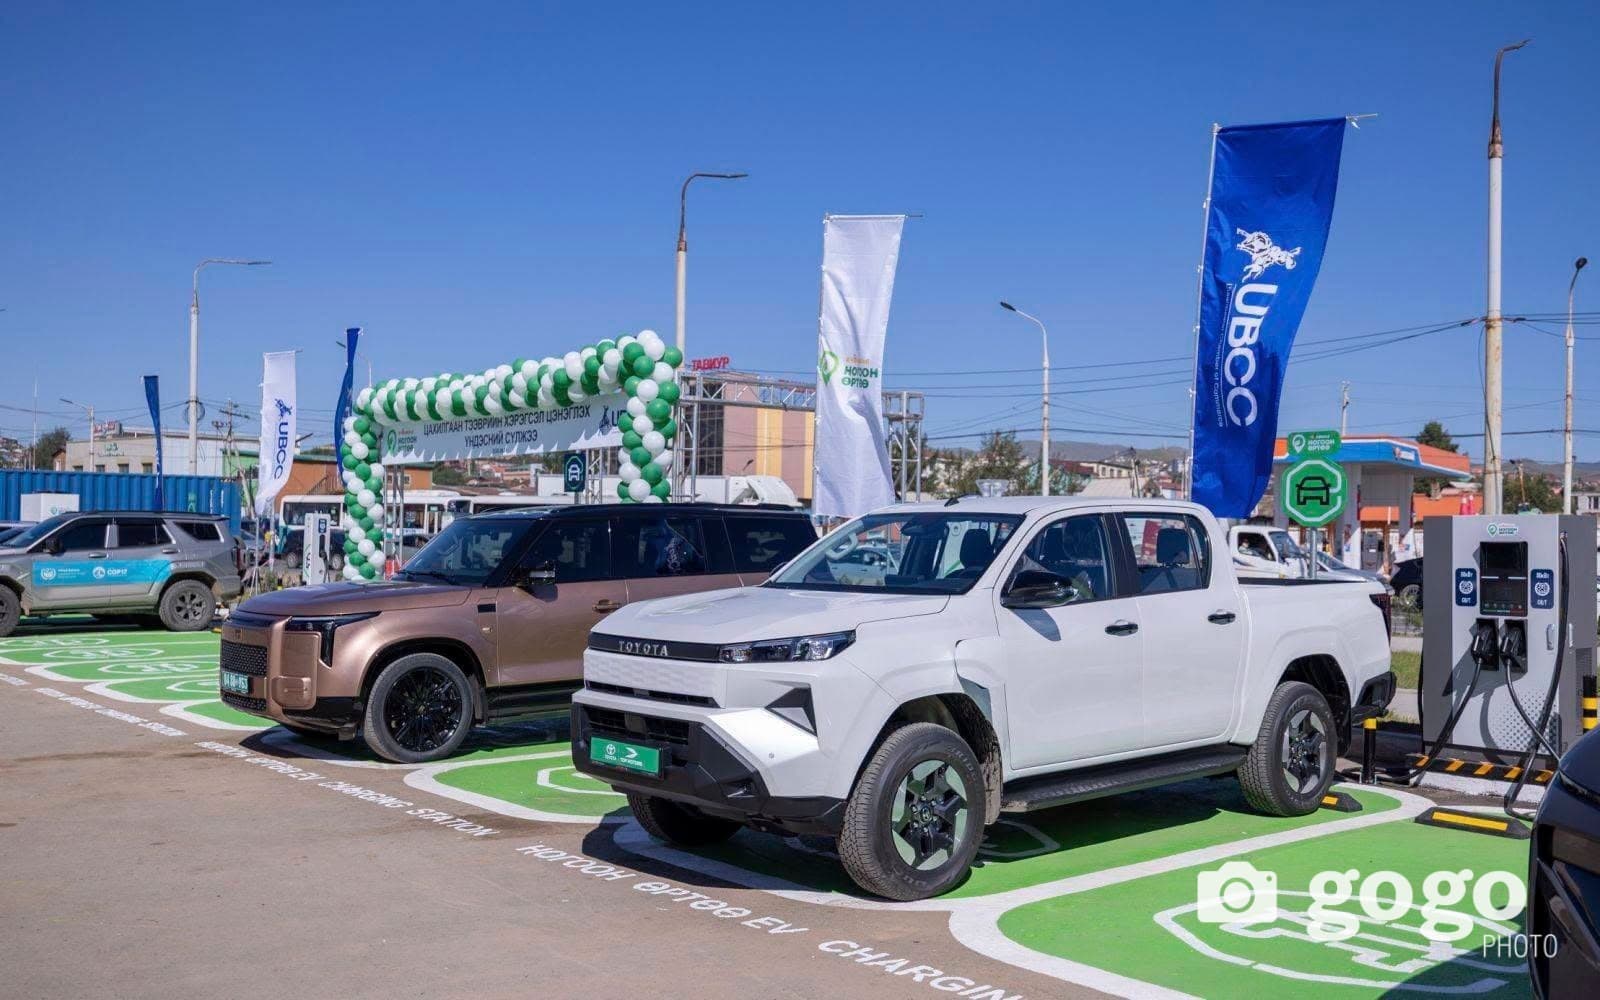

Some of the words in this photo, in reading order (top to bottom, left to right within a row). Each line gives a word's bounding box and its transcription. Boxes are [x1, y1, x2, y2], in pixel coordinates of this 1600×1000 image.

[1224, 283, 1278, 427] UBCC
[423, 420, 463, 437] ЦАХИЛГААН
[464, 415, 503, 431] ТЭЭВРИЙН
[504, 411, 545, 427] ХЭРЭГСЭЛ
[546, 404, 591, 423] ЦЭНЭГЛЭХ
[274, 421, 289, 480] UBCC
[464, 430, 504, 448] ҮНДЭСНИЙ
[504, 429, 538, 444] СҮЛЖЭЭ
[619, 640, 668, 656] TOYOTA
[406, 808, 500, 837] STATION
[516, 844, 637, 881] НОГООН
[633, 881, 752, 918] ӨРТӨӨ
[741, 916, 810, 935] EV
